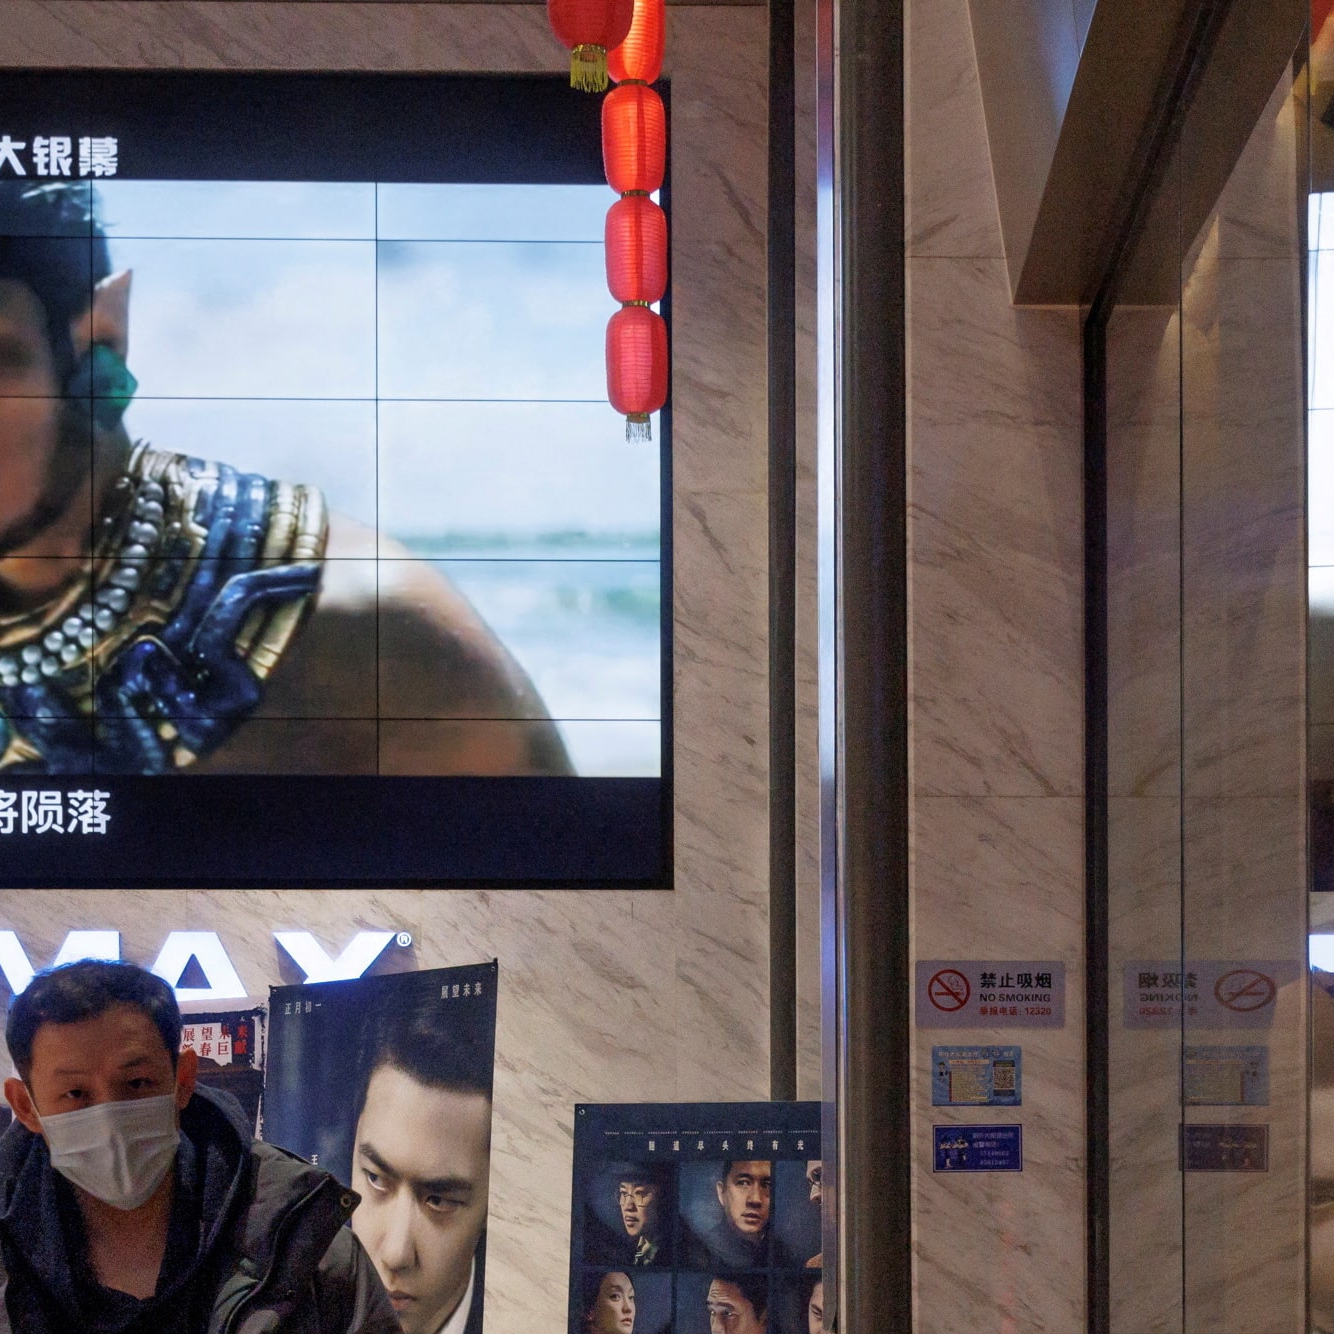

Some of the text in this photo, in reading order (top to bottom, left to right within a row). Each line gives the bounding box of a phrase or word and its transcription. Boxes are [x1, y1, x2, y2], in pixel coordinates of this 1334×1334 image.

[979, 972, 1052, 989] 禁止吸烟
[440, 981, 482, 999] 展望未来
[979, 993, 1051, 1002] NO SMOKING
[284, 1001, 322, 1015] 正月初一
